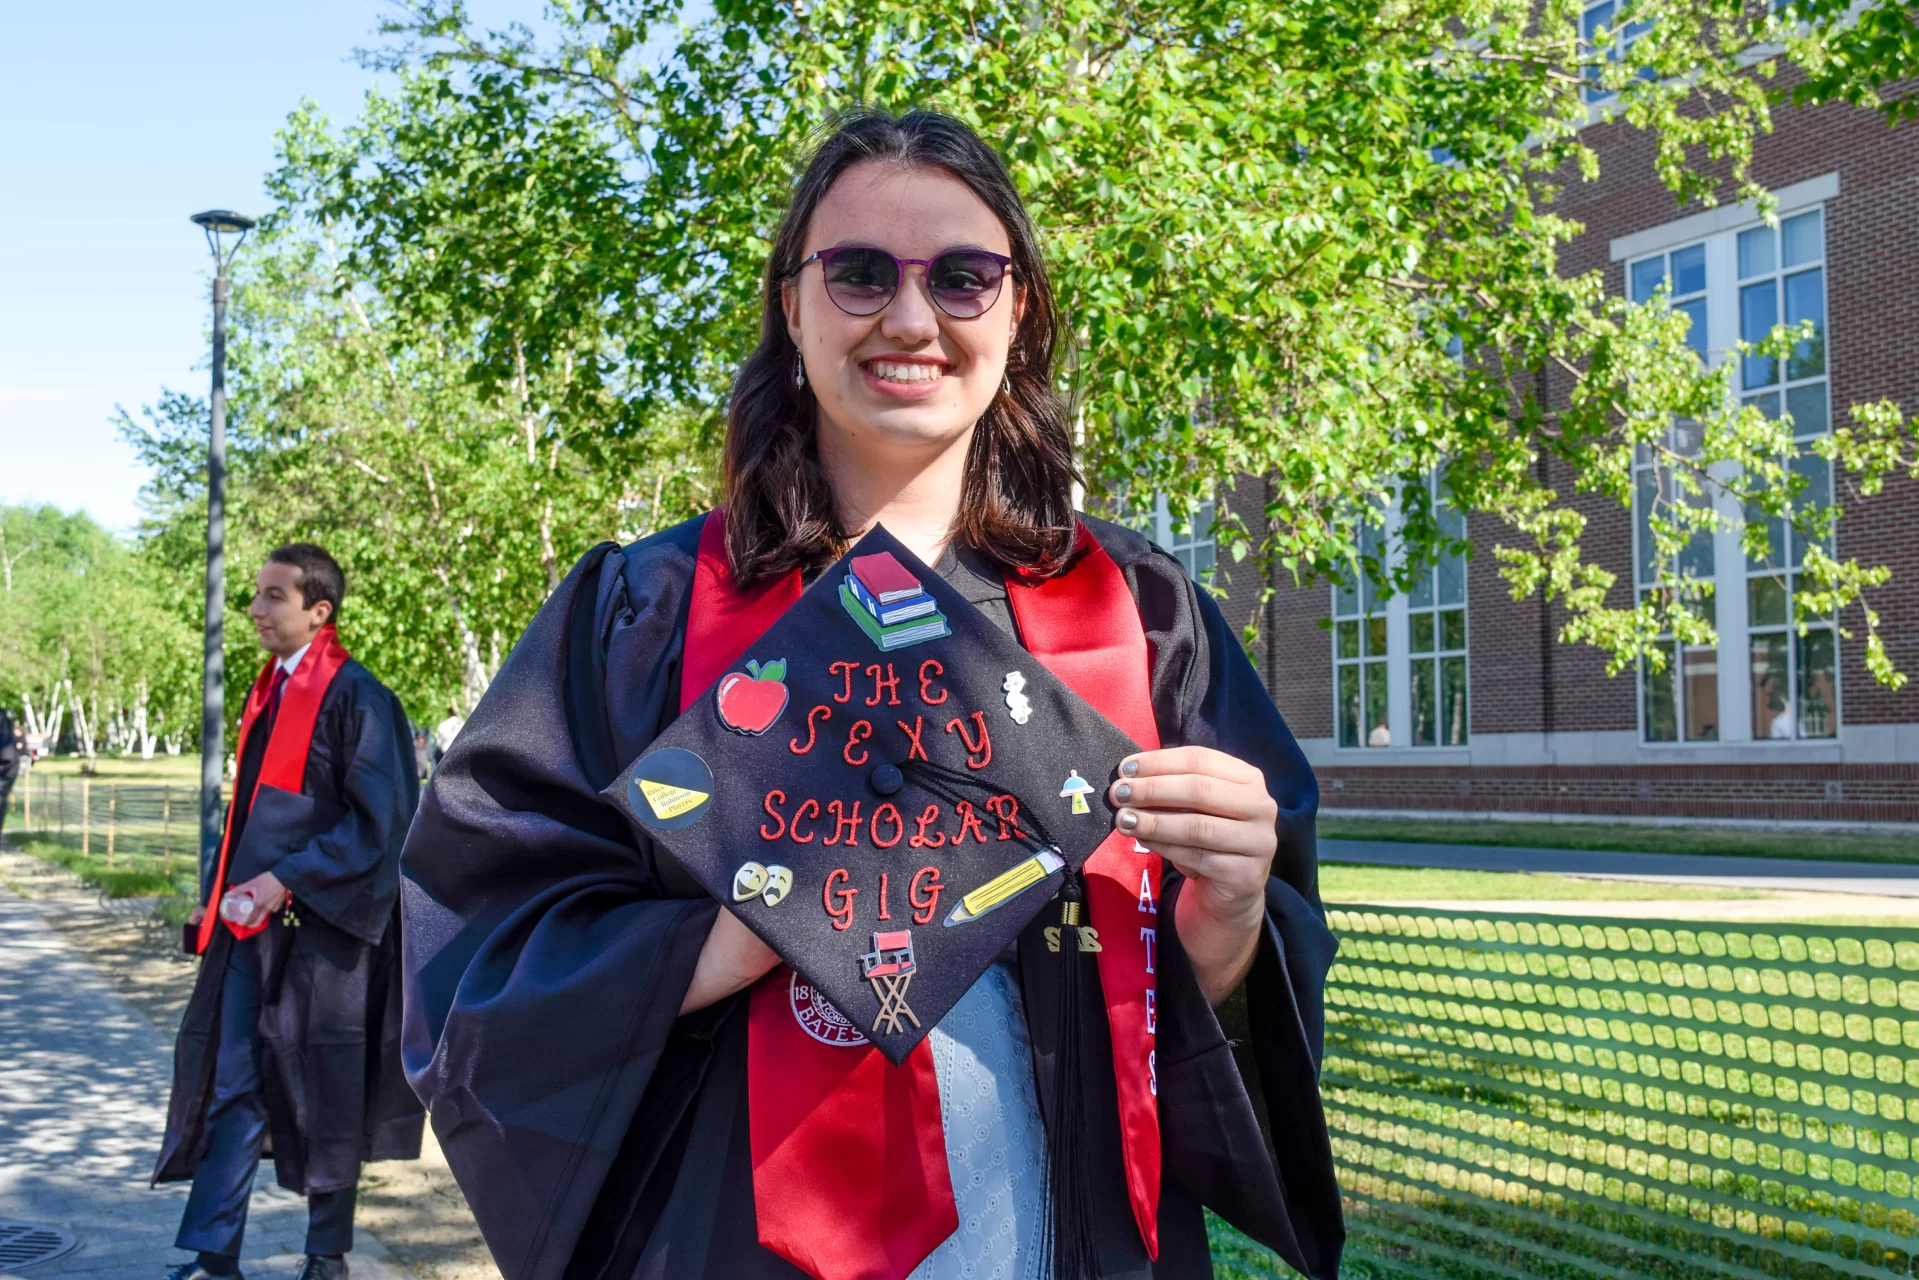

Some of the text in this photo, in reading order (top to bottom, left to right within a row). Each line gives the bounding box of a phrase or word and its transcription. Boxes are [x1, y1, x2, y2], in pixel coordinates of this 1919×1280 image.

[829, 659, 948, 706] THE
[789, 705, 992, 769] SEXY
[646, 786, 664, 796] Bates
[653, 789, 676, 802] College
[661, 791, 692, 807] Robinson
[668, 799, 692, 812] Players
[760, 789, 1030, 848] SCHOLAR
[823, 866, 945, 930] GIG
[799, 1006, 865, 1041] BATES
